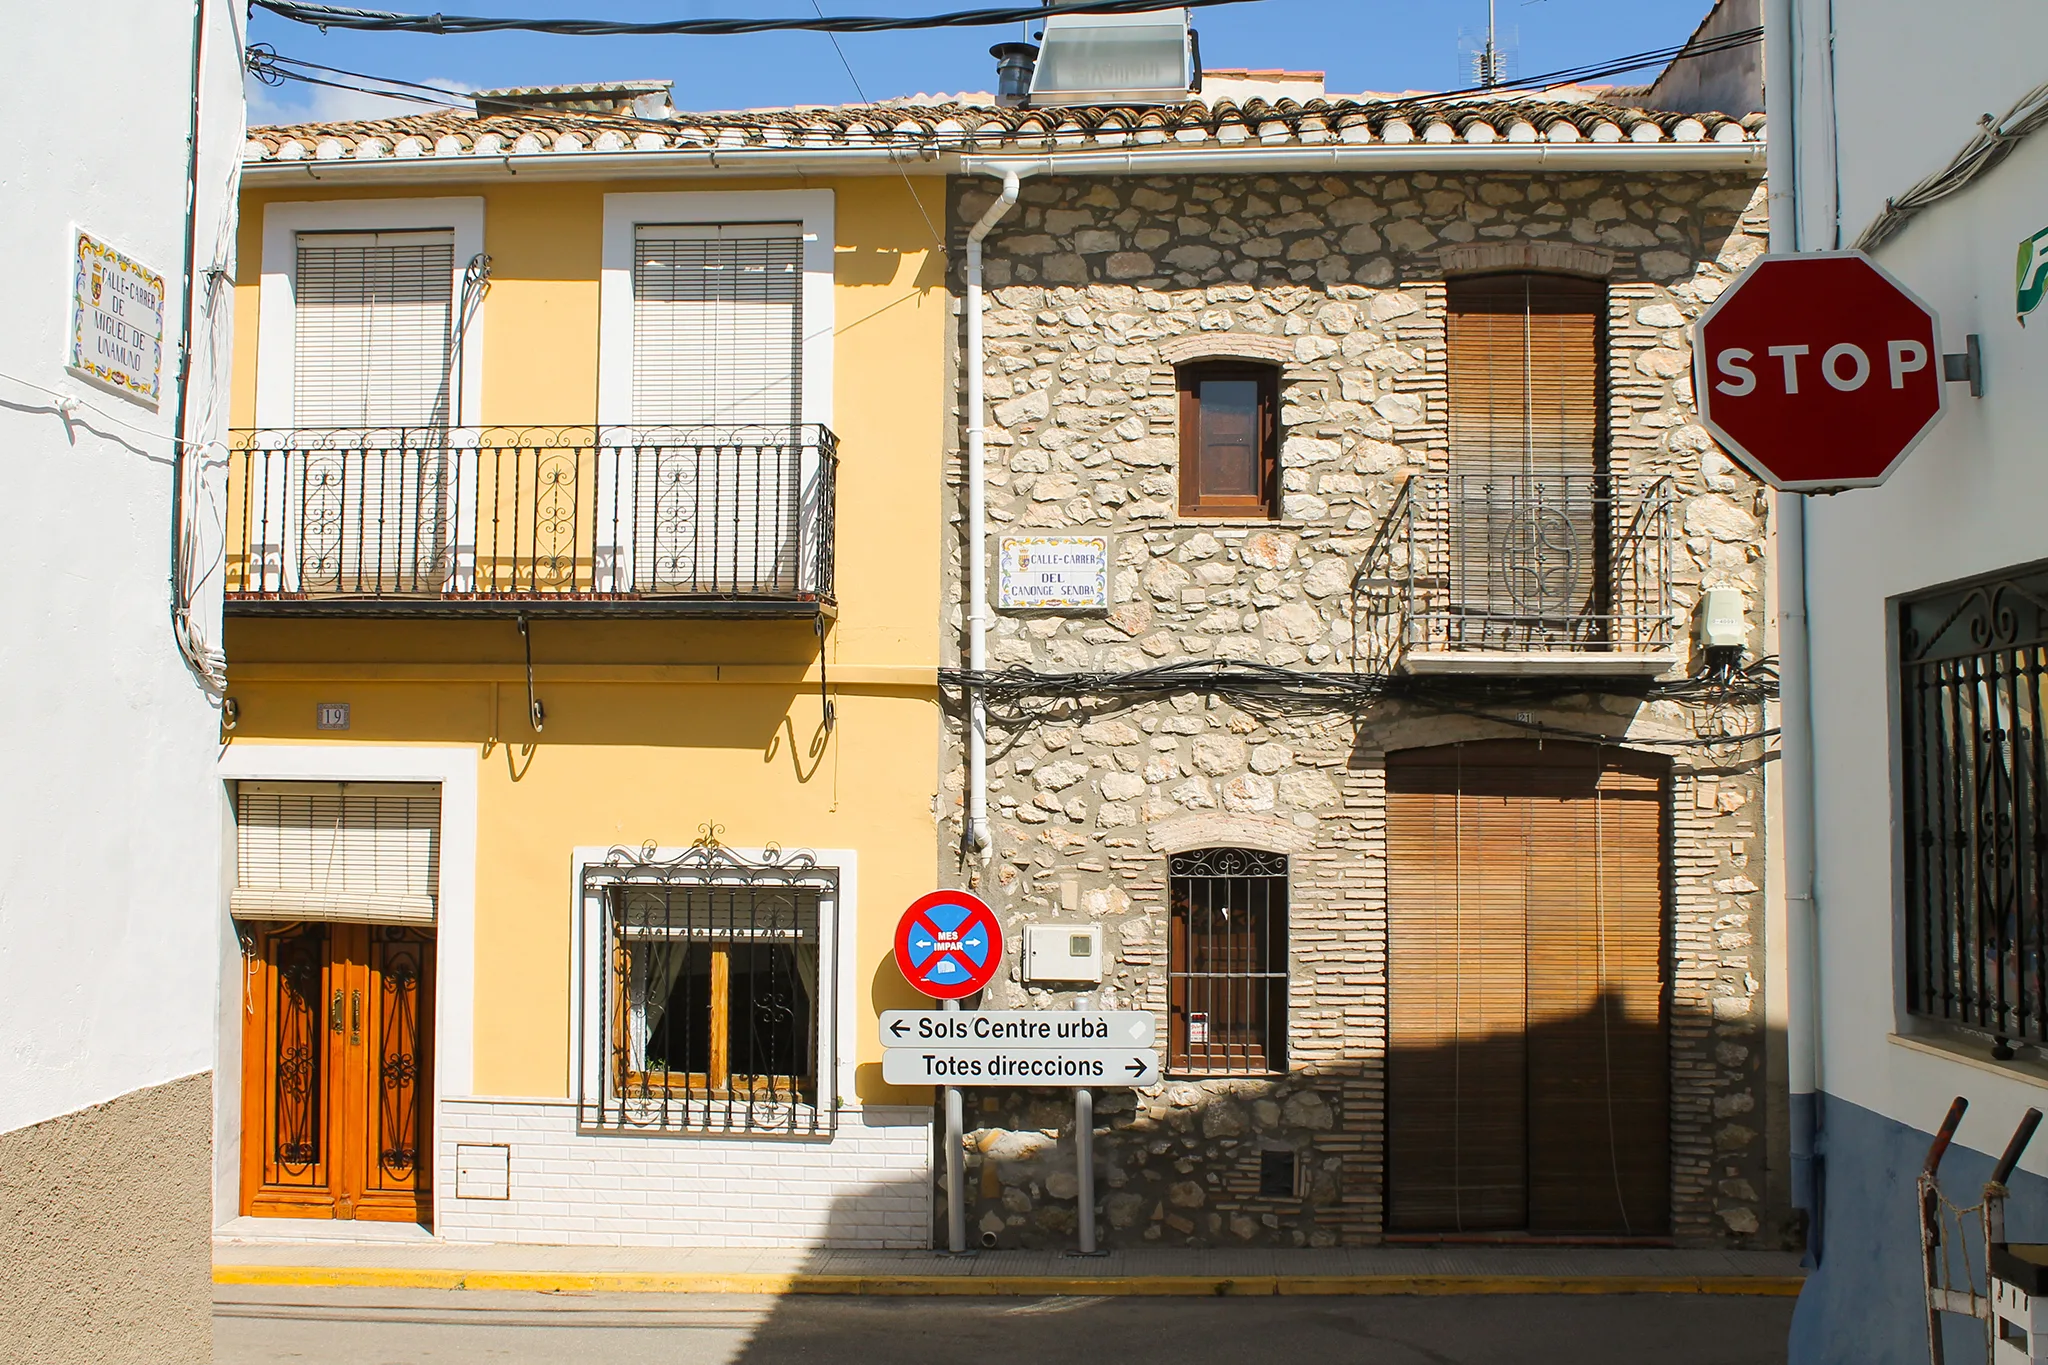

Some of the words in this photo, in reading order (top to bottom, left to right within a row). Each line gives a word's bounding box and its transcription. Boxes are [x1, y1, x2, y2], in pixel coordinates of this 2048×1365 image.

[102, 267, 156, 311] CALLE-CARRER
[112, 295, 125, 317] DE
[94, 310, 128, 343] MIGUEL
[132, 330, 145, 351] DE
[97, 336, 141, 372] UNAMUNO
[1715, 339, 1928, 397] STOP
[1030, 554, 1096, 565] CALLE-CARRER
[1041, 573, 1065, 583] DEL
[1011, 586, 1054, 596] CANONGE
[1060, 585, 1095, 596] SENDRA
[325, 709, 342, 724] 19
[933, 941, 964, 952] IMPAR
[937, 931, 958, 941] MES
[918, 1017, 968, 1039] Sols
[973, 1017, 1051, 1039] Centre
[1057, 1016, 1109, 1039] urbà
[922, 1055, 982, 1076] Totes
[987, 1055, 1104, 1076] direccions
